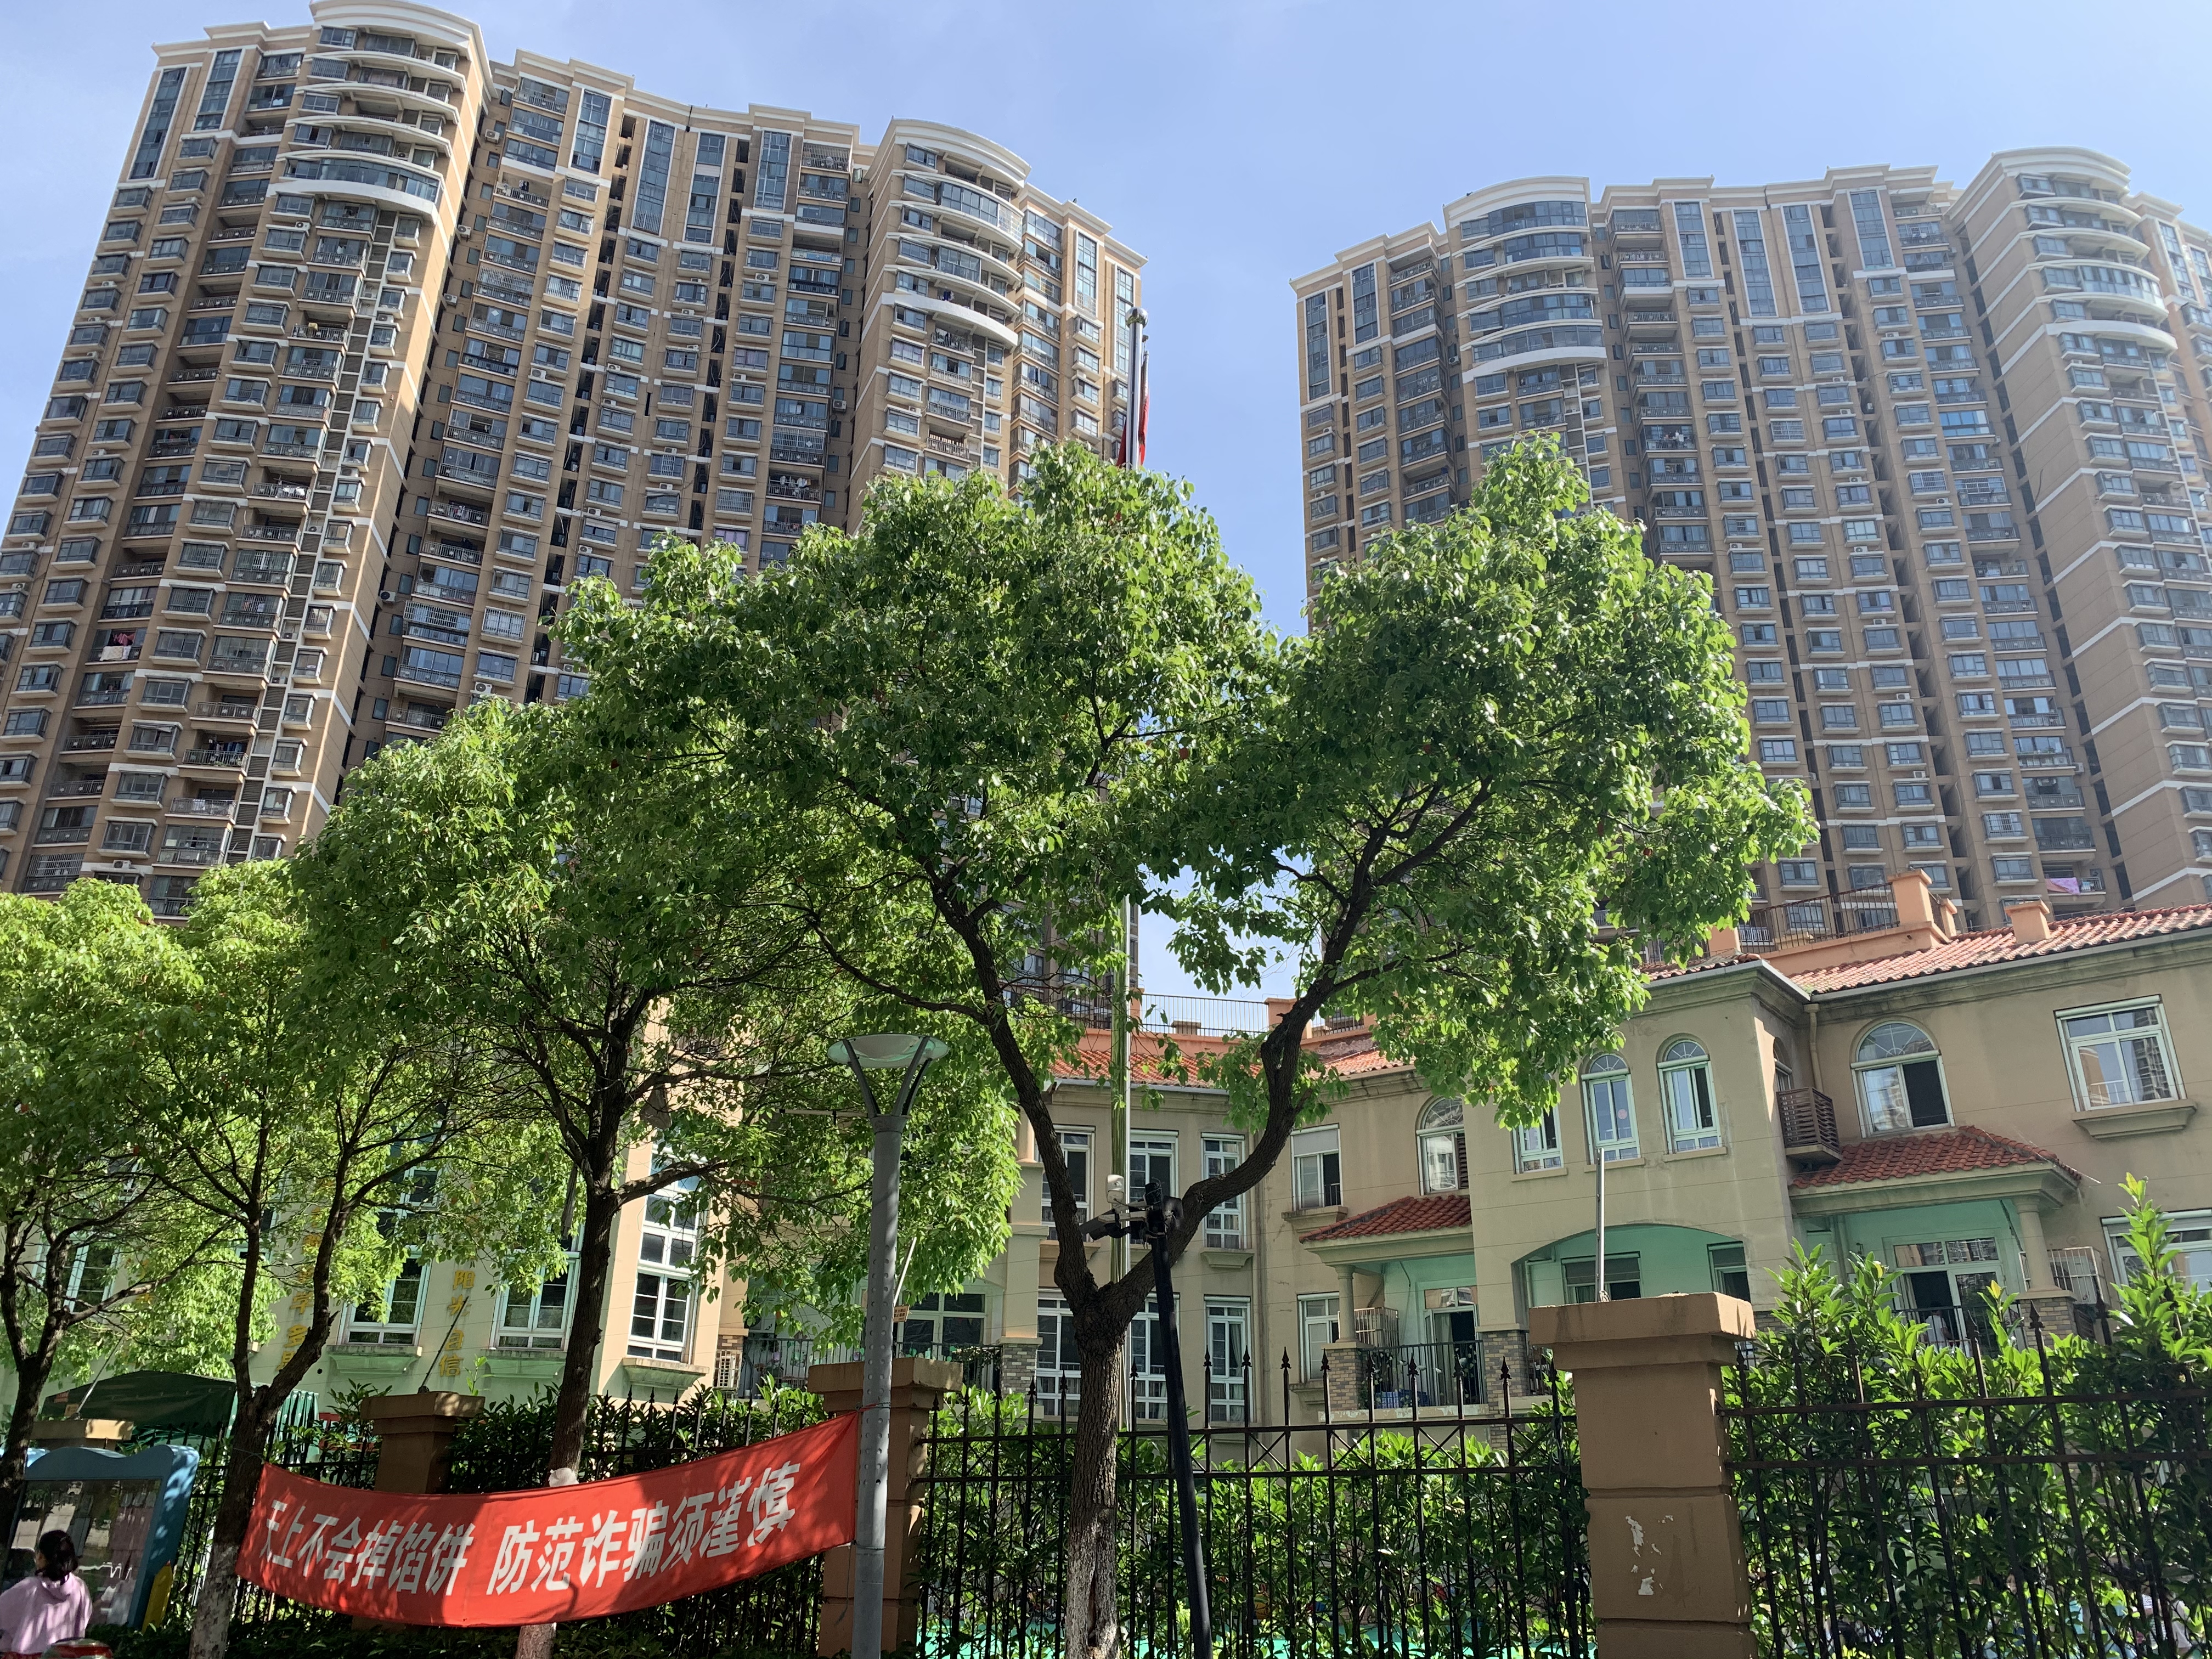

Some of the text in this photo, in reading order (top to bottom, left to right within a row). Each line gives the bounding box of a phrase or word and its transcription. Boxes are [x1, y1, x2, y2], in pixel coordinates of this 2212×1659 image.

[260, 1460, 800, 1595] 天上不会掉馅饼 防范诈骗须谨慎
